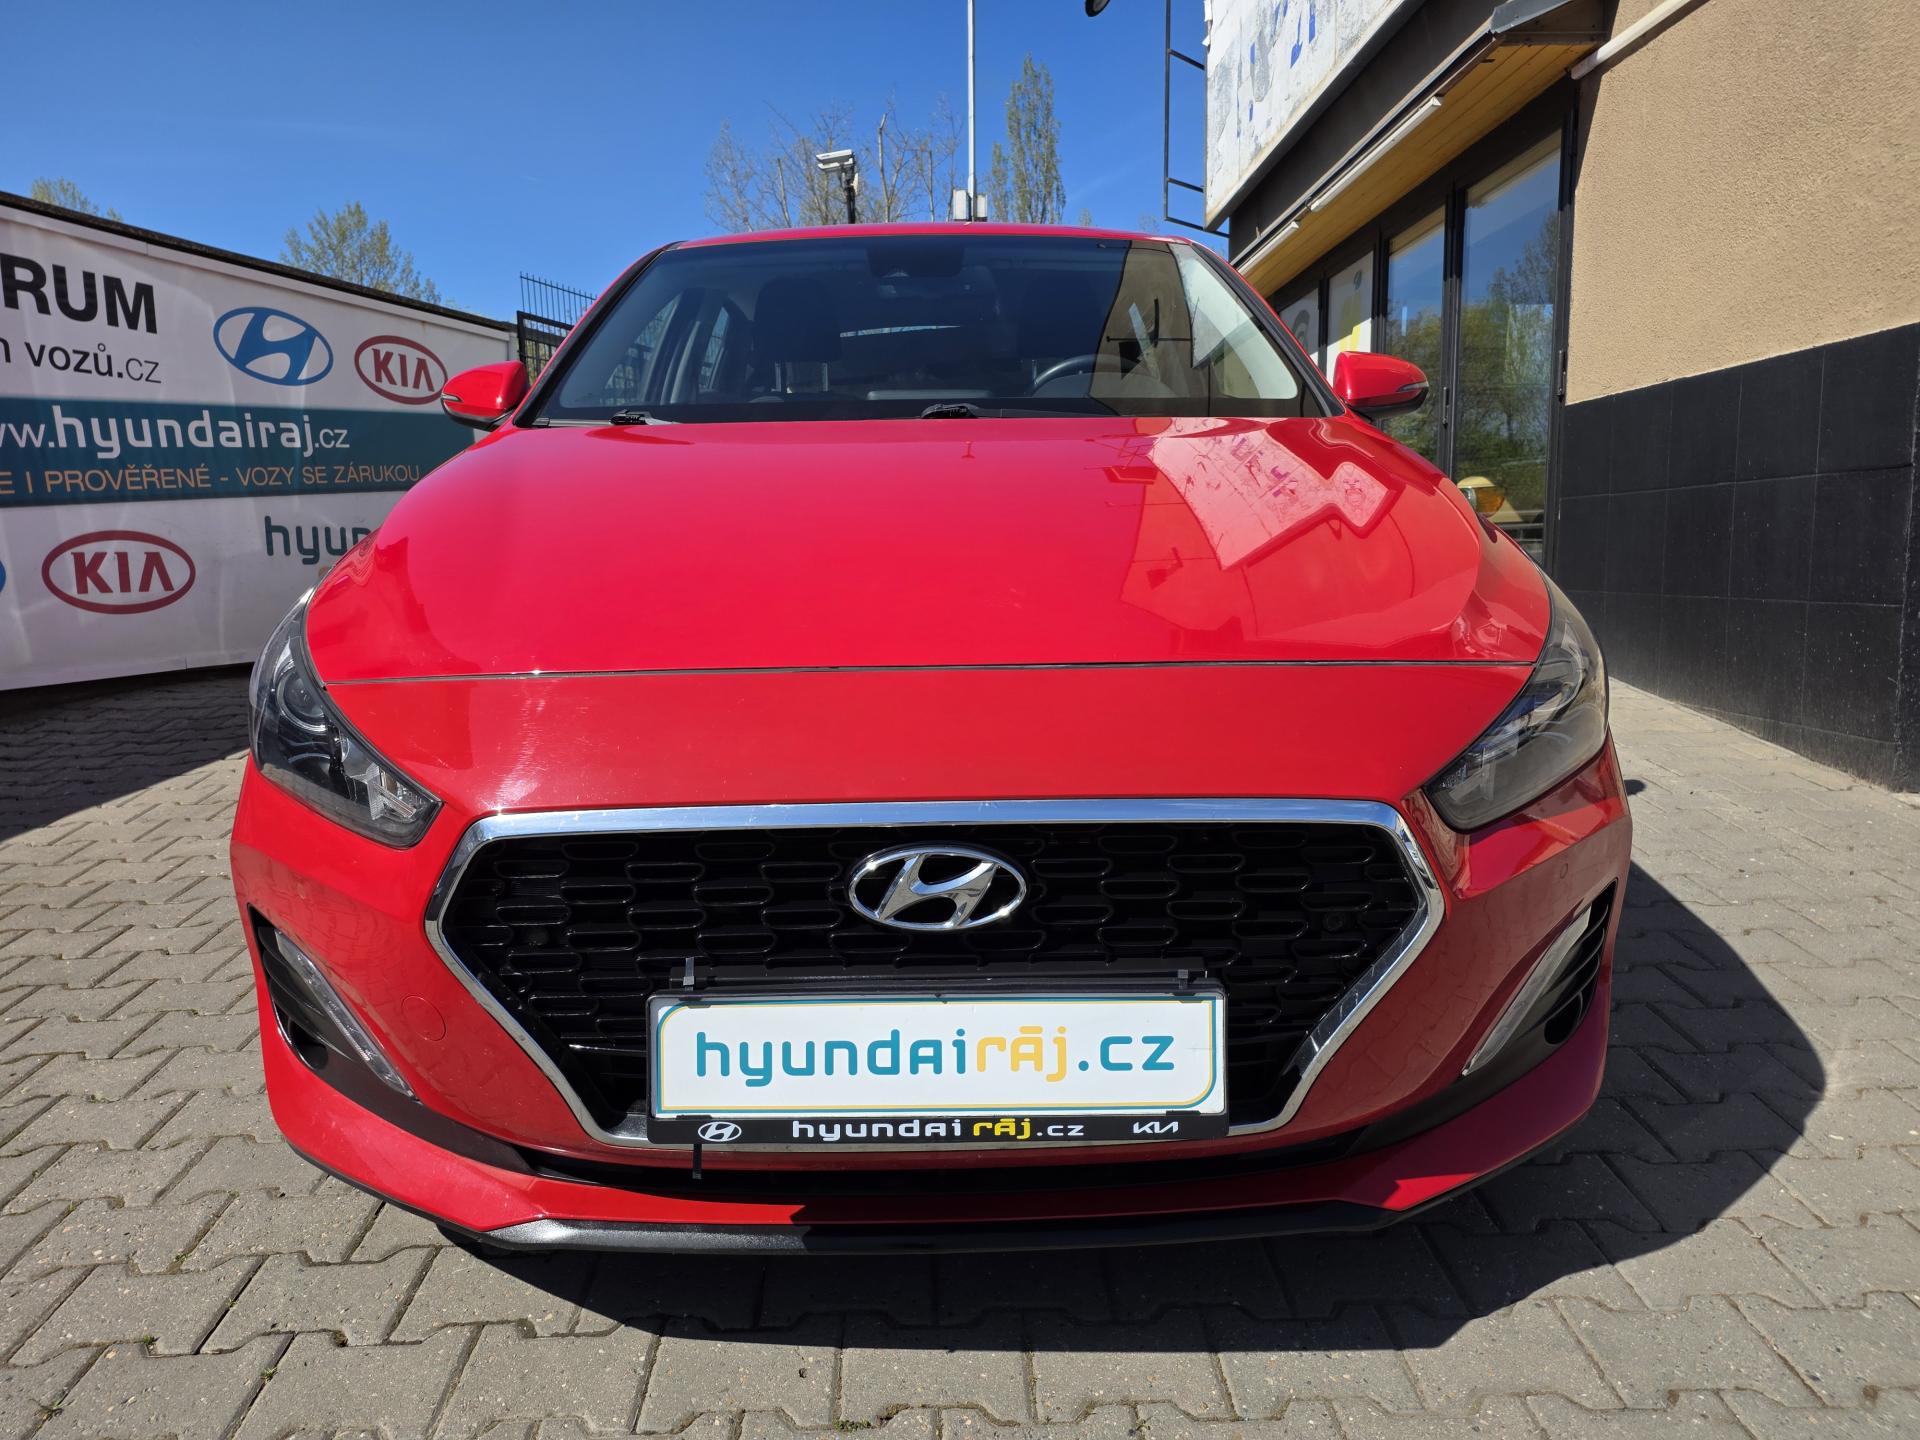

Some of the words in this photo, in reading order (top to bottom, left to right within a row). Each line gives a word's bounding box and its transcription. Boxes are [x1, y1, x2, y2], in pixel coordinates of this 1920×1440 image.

[24, 341, 162, 384] vozů.cz
[371, 347, 435, 392] KIA
[0, 404, 350, 460] w.hyundairaj.cz
[44, 463, 212, 493] PROVĚŘENÉ
[235, 466, 294, 487] VOZY
[302, 466, 328, 484] SE
[333, 461, 420, 484] ZÁRUKOU
[71, 552, 174, 595] KIA
